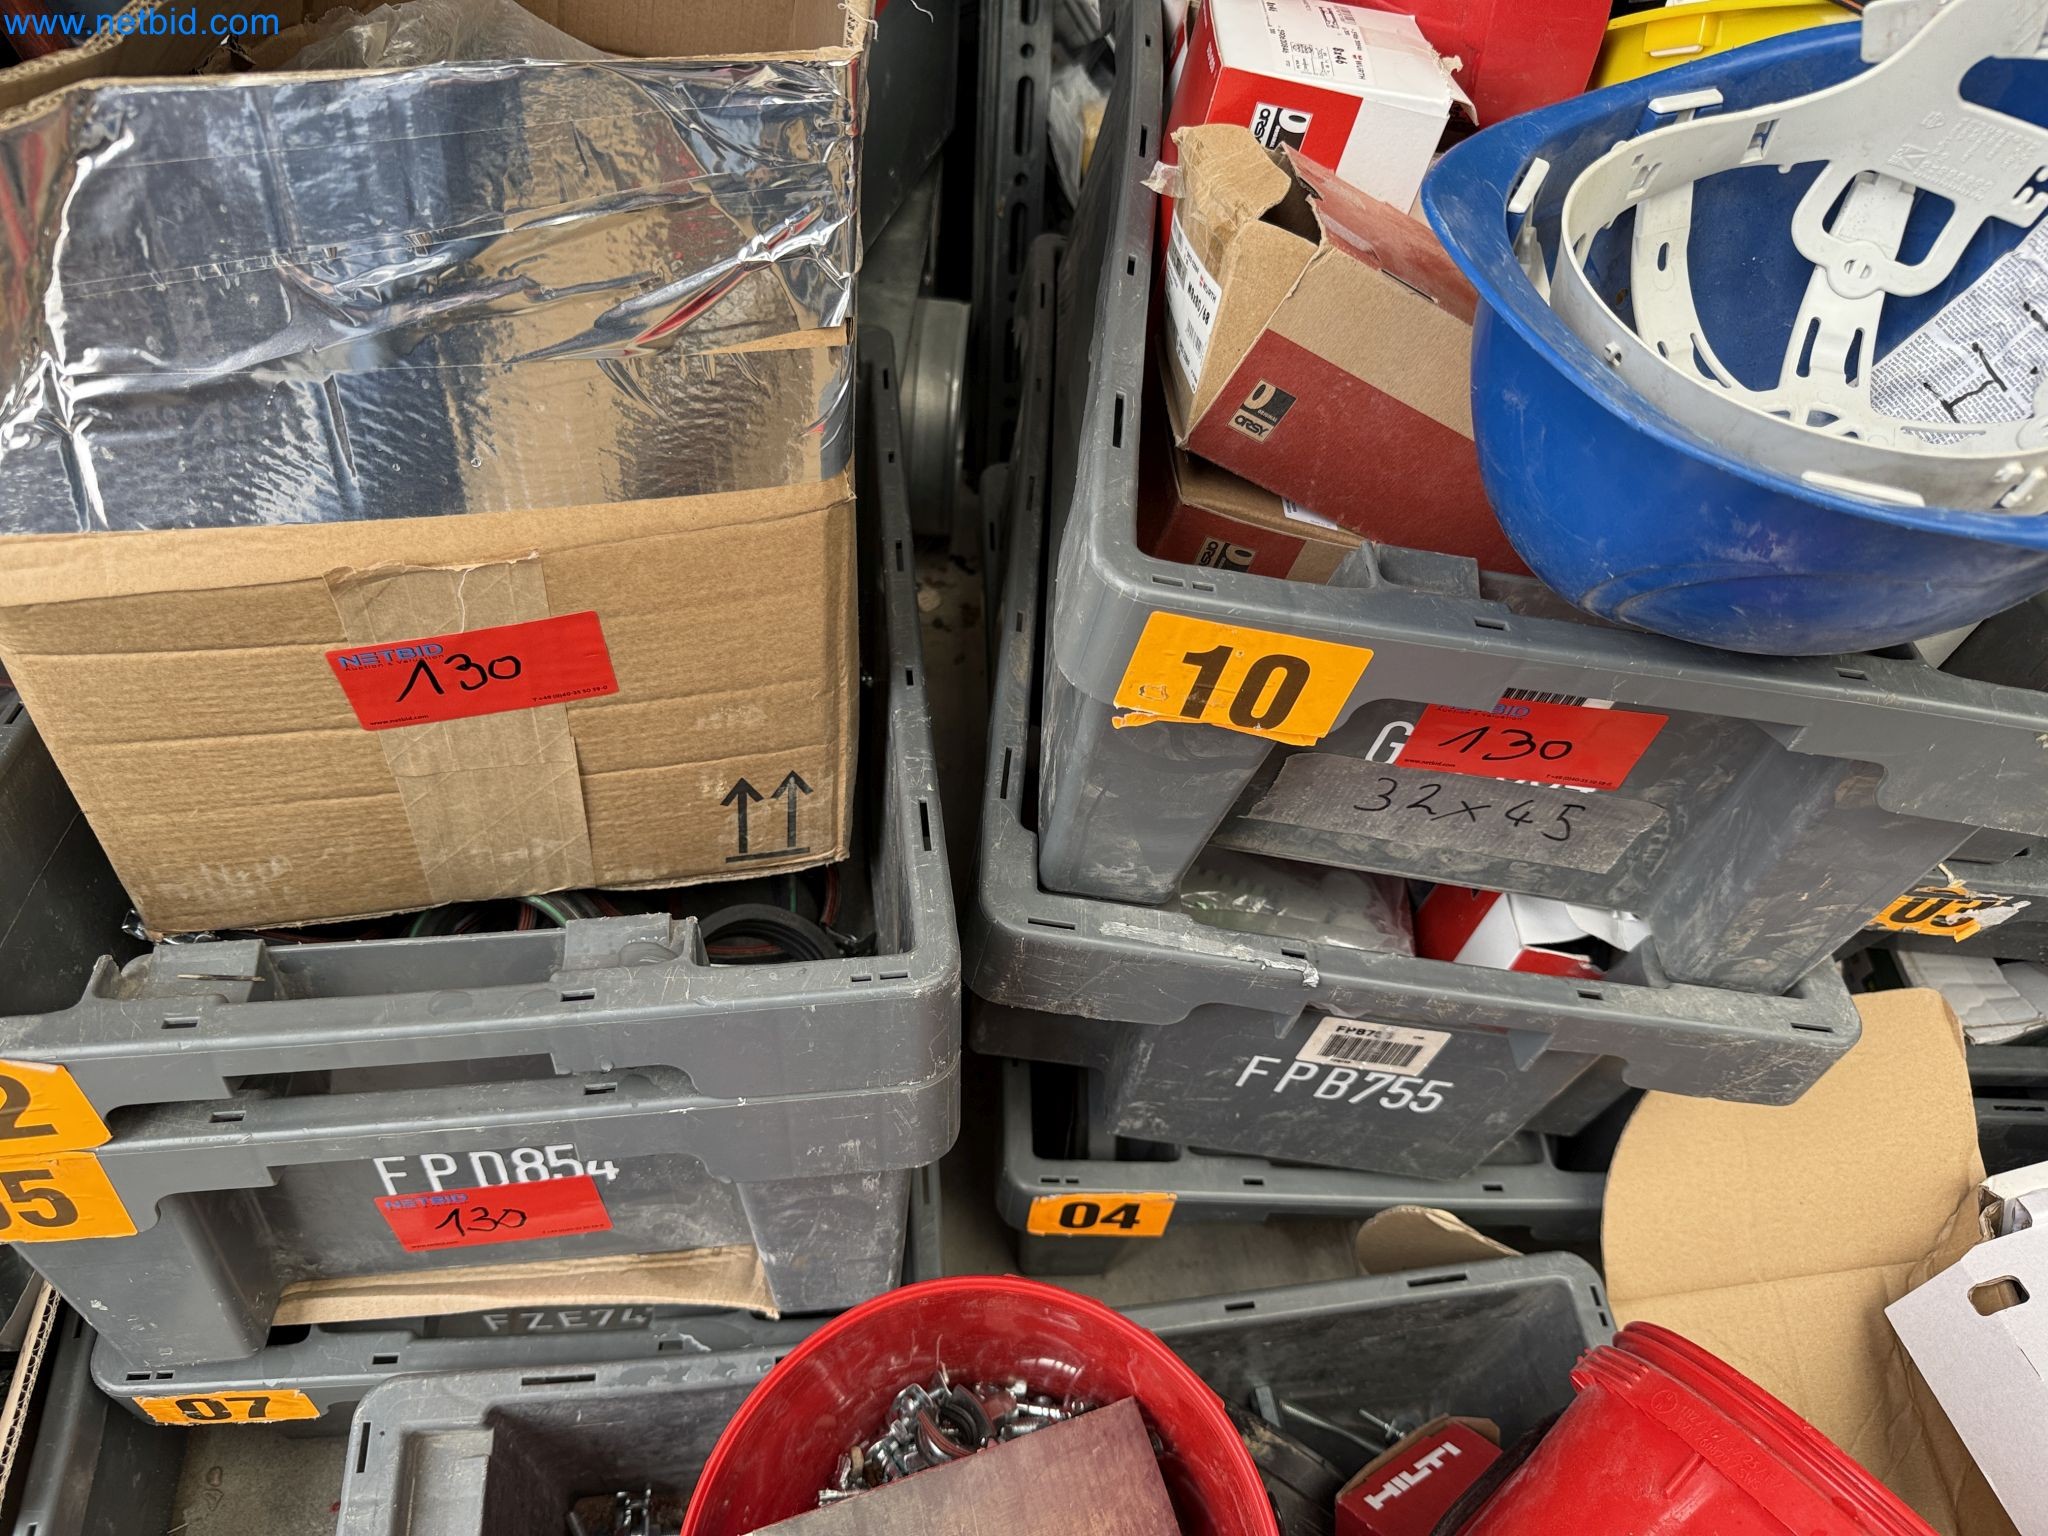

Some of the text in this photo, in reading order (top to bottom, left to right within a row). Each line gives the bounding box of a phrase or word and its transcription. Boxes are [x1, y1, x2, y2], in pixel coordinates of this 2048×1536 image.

[1234, 414, 1270, 437] ORSY
[1199, 541, 1219, 566] ORS
[338, 643, 444, 668] NETBID
[396, 653, 522, 702] 130
[1179, 644, 1312, 730] 10
[1437, 726, 1573, 761] 130
[0, 1169, 78, 1230] 5
[1058, 1202, 1141, 1228] 04
[434, 1206, 527, 1237] 130
[175, 1397, 271, 1421] 07
[1363, 1441, 1463, 1511] HILTI
